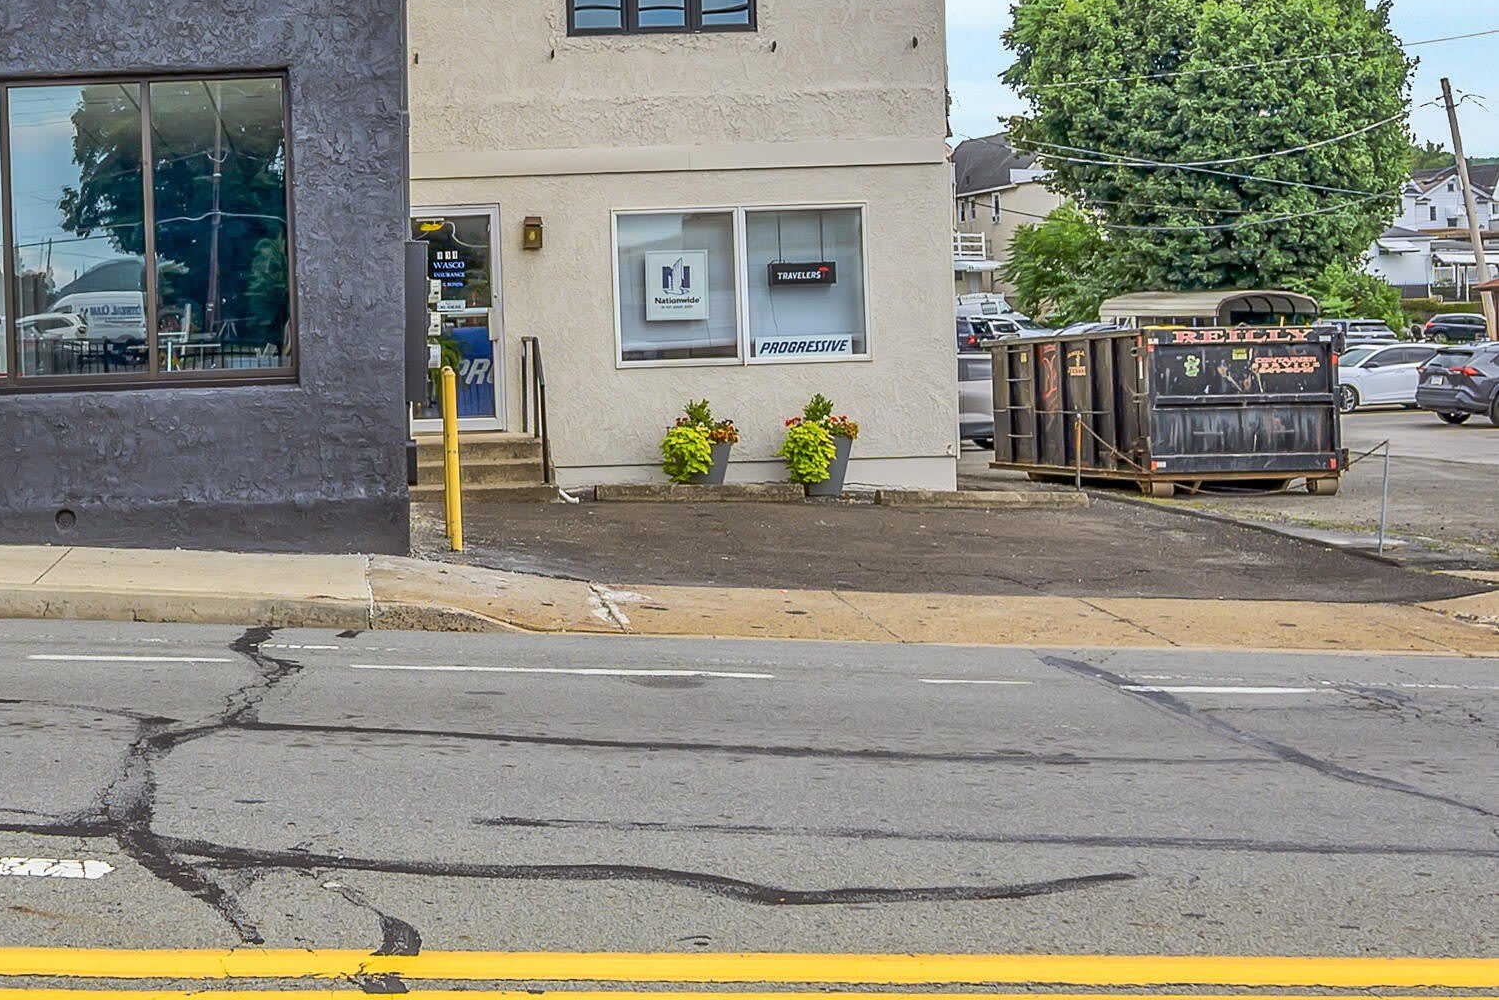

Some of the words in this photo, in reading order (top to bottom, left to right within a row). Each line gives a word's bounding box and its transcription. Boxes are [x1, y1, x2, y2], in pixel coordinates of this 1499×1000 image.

[433, 261, 465, 269] WASCO
[777, 271, 821, 280] TRAVELERS
[654, 296, 700, 304] Nationwide
[1172, 329, 1314, 343] REILLY
[760, 340, 848, 354] PROGRESSIVE
